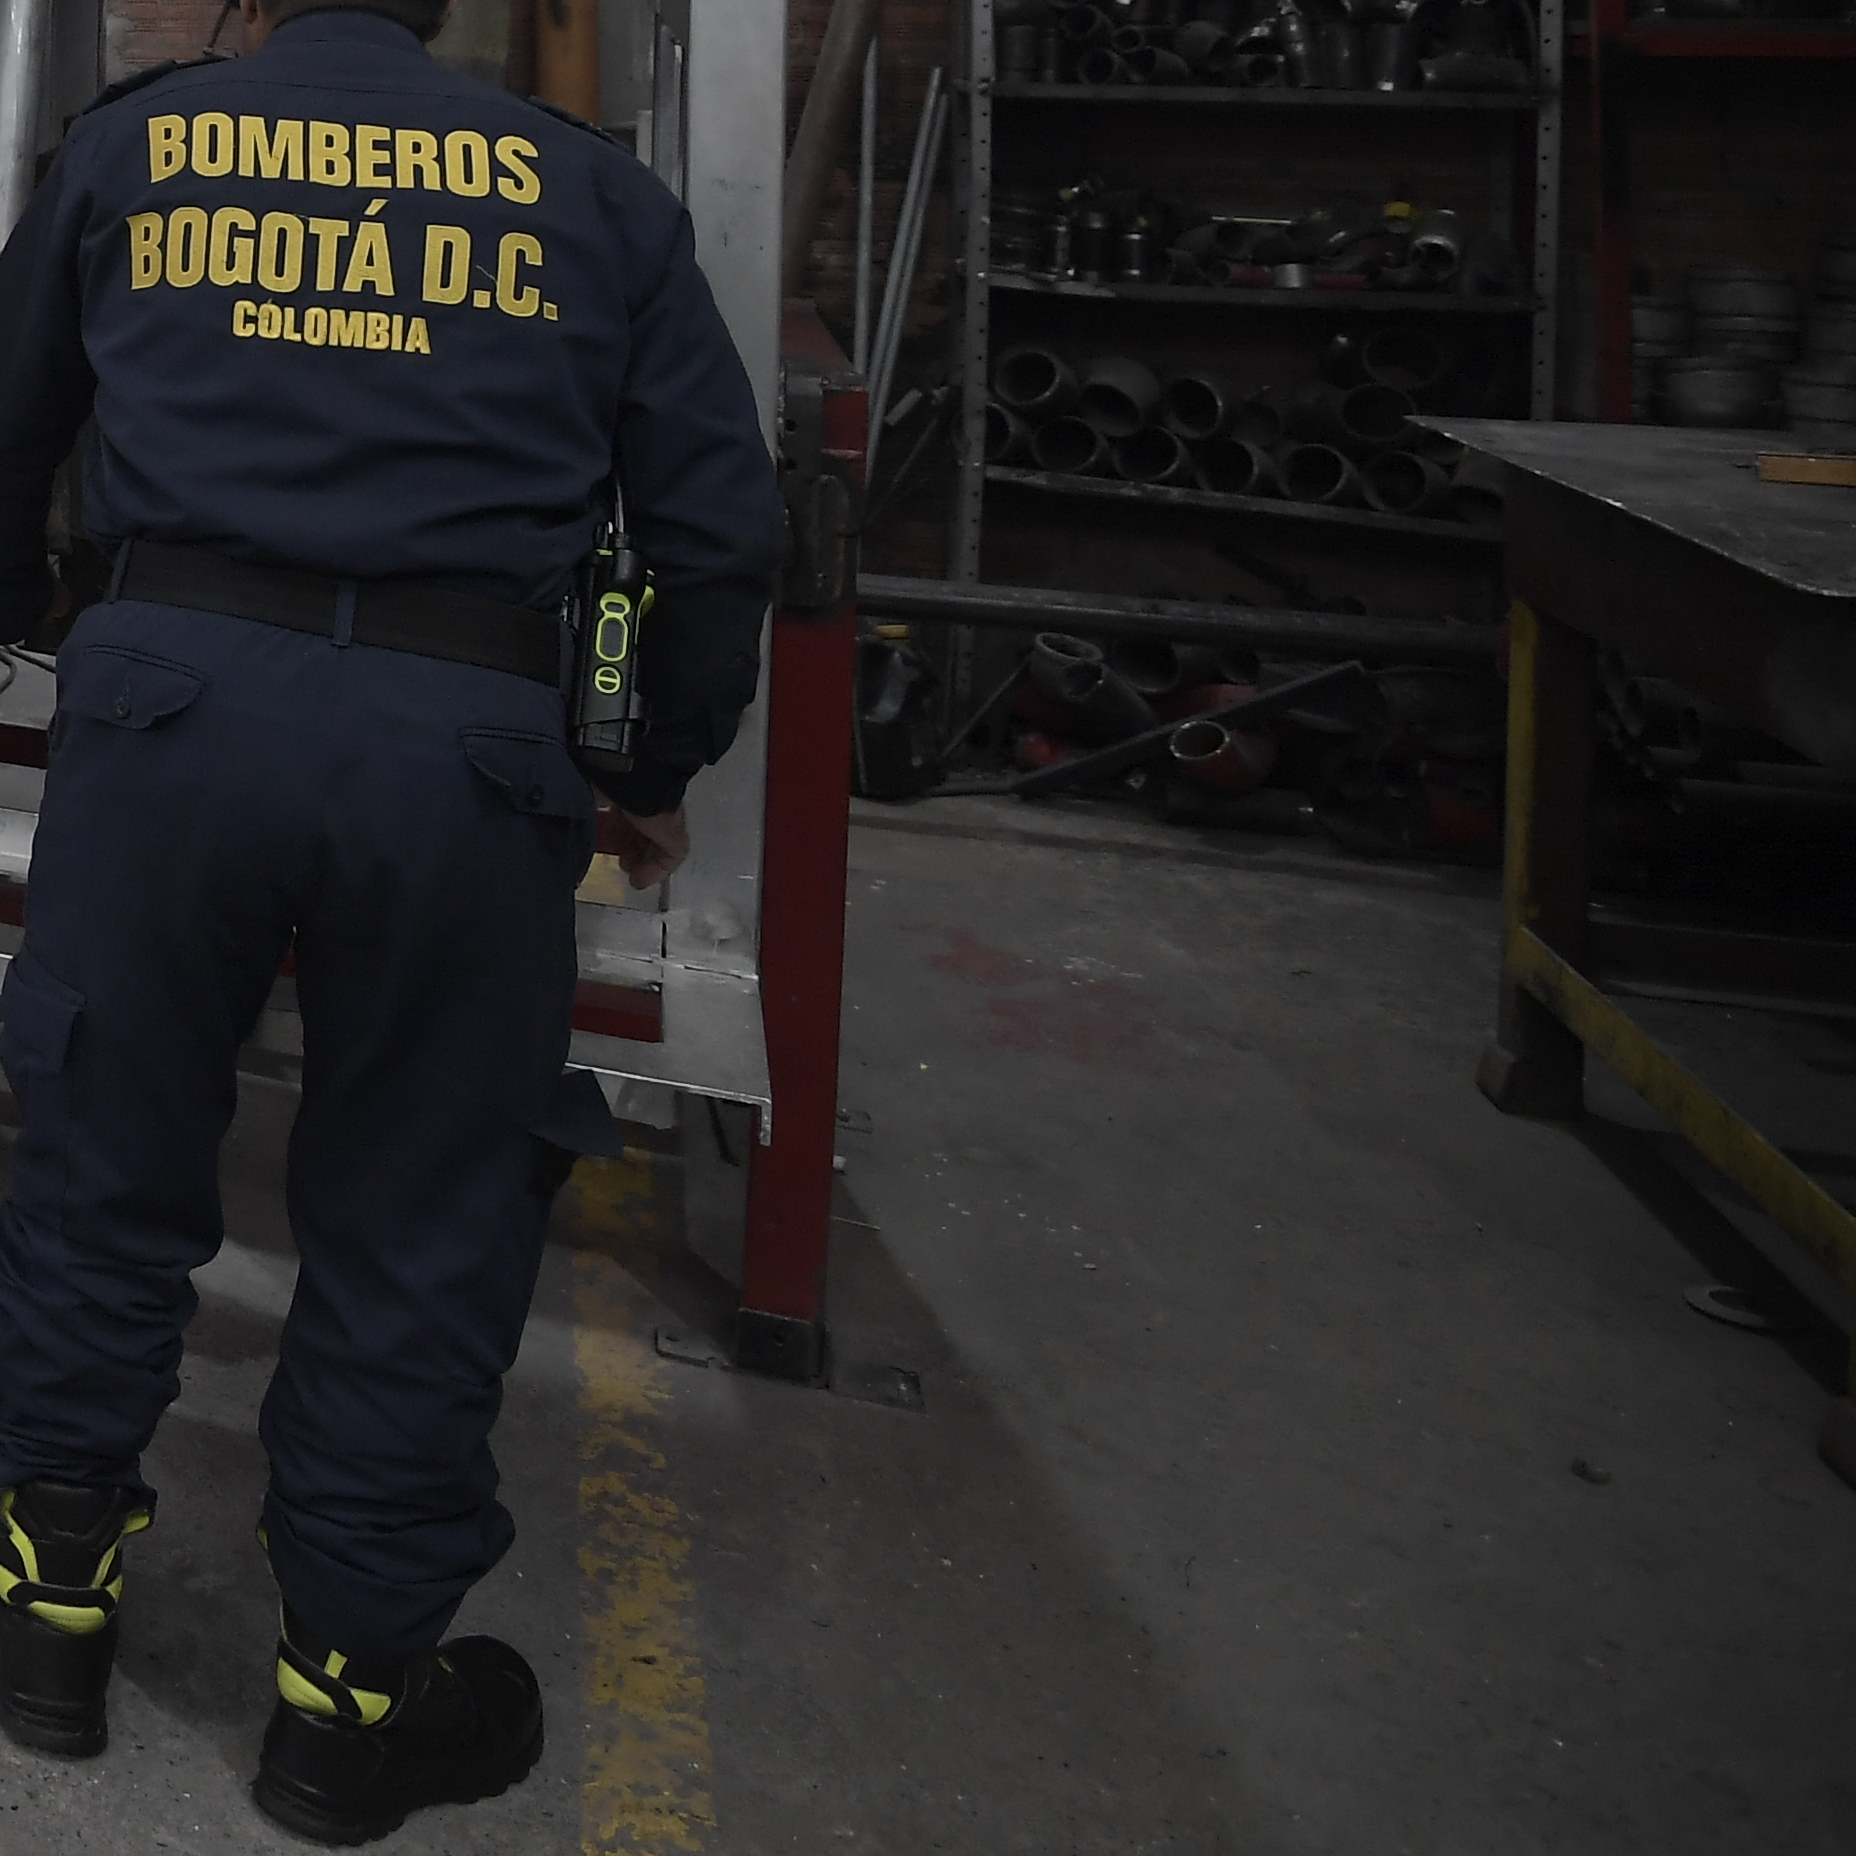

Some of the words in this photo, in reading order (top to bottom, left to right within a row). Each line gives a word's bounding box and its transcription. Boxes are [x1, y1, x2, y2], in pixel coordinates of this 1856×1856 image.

[147, 111, 542, 205] BOMBEROS
[125, 198, 396, 297] BOGOTÁ
[421, 223, 560, 322] D.C.
[231, 298, 432, 356] COLOMBIA
